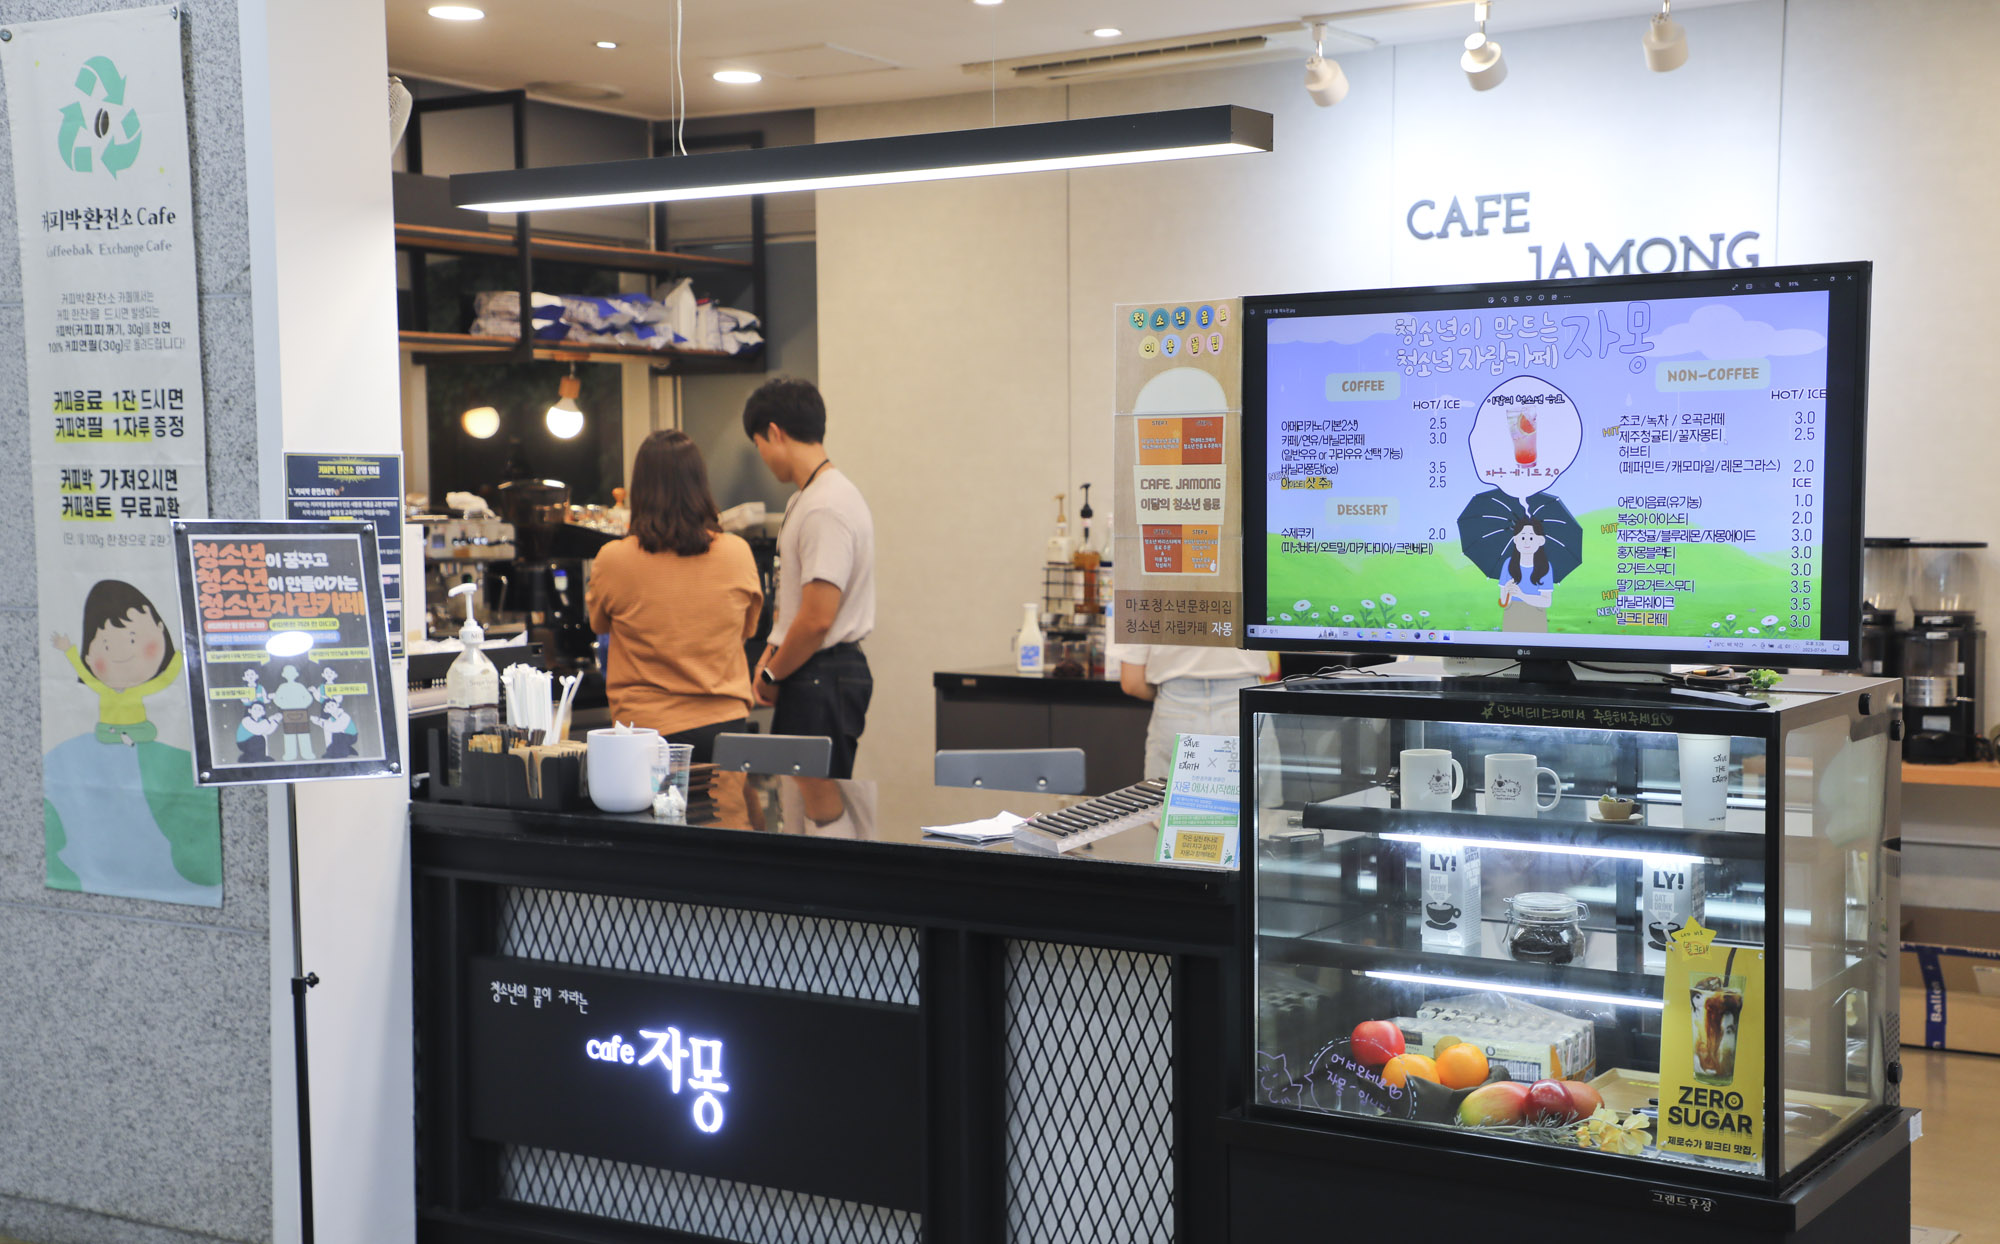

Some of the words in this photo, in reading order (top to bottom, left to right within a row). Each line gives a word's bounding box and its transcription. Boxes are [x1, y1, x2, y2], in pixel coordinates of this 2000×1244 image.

[137, 206, 176, 226] Cafe
[1407, 192, 1530, 240] CAFE
[99, 242, 144, 258] Exchange
[146, 240, 173, 252] Cafe
[1133, 311, 1186, 328] 청소년
[1395, 316, 1482, 346] 청소년이
[1494, 311, 1559, 343] 만드는
[1561, 301, 1655, 374] 자몽
[1144, 339, 1174, 354] 이용
[1397, 347, 1453, 377] 청소년
[1457, 341, 1559, 376] 자립카페
[1667, 367, 1759, 382] NON-COFFEE
[1342, 380, 1385, 392] COFFEE
[54, 390, 103, 411] 커피음료
[112, 390, 136, 411] 1잔
[141, 388, 184, 410] 드시면
[1771, 389, 1804, 400] HOT/
[1807, 388, 1827, 399] ICE
[1413, 399, 1440, 410] HOT/
[1444, 400, 1460, 409] ICE
[1281, 420, 1359, 432] 아메리카노(기본2샷)
[1429, 417, 1447, 430] 2.5
[1619, 414, 1669, 427] 초코/녹차
[1681, 413, 1725, 427] 오곡라떼
[1794, 411, 1816, 424] 3.0
[55, 416, 103, 438] 커피연필
[113, 416, 150, 437] 1자루
[154, 416, 184, 438] 증정
[1602, 426, 1620, 438] HIT
[1429, 432, 1447, 444] 3.0
[1619, 429, 1722, 443] 제주청귤티/꿀자몽티
[1794, 428, 1816, 441] 2.5
[1319, 451, 1326, 460] or
[1328, 448, 1362, 461] 귀리우유
[1364, 448, 1381, 460] 선택
[1383, 447, 1403, 460] 가능)
[1618, 446, 1651, 458] 허브티
[1429, 461, 1446, 474] 3.5
[1545, 468, 1560, 478] 2.0
[1794, 459, 1814, 472] 2.0
[61, 469, 93, 491] 커피박
[100, 469, 178, 491] 가져오시면
[1140, 478, 1173, 490] CAFE.
[1175, 478, 1221, 490] JAMONG
[1306, 476, 1316, 489] 샷
[1429, 476, 1446, 488] 2.5
[1792, 478, 1812, 488] ICE
[62, 496, 112, 518] 커피점토
[121, 496, 180, 519] 무료교환
[1173, 498, 1201, 511] 청소년
[1203, 498, 1221, 510] 음료
[1618, 496, 1702, 509] 어린이음료(유기농)
[1794, 494, 1812, 507] 1.0
[1337, 504, 1388, 516] DESSERT
[1618, 513, 1648, 526] 복숭아
[1648, 512, 1688, 525] 아이스티
[1792, 511, 1812, 524] 2.0
[1281, 527, 1314, 539] 수제쿠키
[1428, 528, 1446, 540] 2.0
[1601, 523, 1618, 534] HIT
[1792, 528, 1812, 542] 3.0
[193, 542, 282, 569] 청소년이
[283, 550, 329, 569] 꿈꾸고
[1617, 546, 1676, 560] 홍자몽블랙티
[1791, 546, 1812, 559] 3.0
[1617, 563, 1676, 576] 요거트스무디
[1790, 563, 1812, 576] 3.0
[196, 568, 285, 594] 청소년이
[285, 575, 359, 592] 만들어가는
[1616, 579, 1694, 592] 딸기요거트스무디
[1790, 580, 1811, 594] 3.5
[1602, 590, 1618, 600] HIT
[1125, 598, 1232, 614] 마포청소년문화의집
[1597, 606, 1620, 617] NEW
[1790, 598, 1810, 611] 3.5
[1126, 619, 1160, 634] 청소년
[1165, 620, 1208, 635] 자립카페
[1211, 621, 1232, 637] 자몽
[1790, 615, 1810, 628] 3.0
[1593, 708, 1662, 727] 주문해주세요
[1183, 739, 1200, 748] SAVE
[1184, 751, 1196, 759] THE
[1713, 753, 1728, 762] SAVE
[1178, 761, 1200, 770] EARTH
[1430, 854, 1456, 872] LY!
[1654, 871, 1684, 890] LY!
[490, 981, 527, 1005] 청소년의
[533, 986, 551, 1008] 꿈이
[558, 989, 588, 1014] 자라는
[586, 1034, 635, 1064] cafe
[637, 1026, 730, 1133] 자몽
[1678, 1085, 1744, 1111] ZERO
[1667, 1106, 1753, 1135] SUGAR
[1667, 1135, 1702, 1149] 제로슈가
[1704, 1140, 1731, 1153] 밀크티
[1733, 1142, 1751, 1155] 맛집
[1652, 1191, 1712, 1212] 그랜드우성
